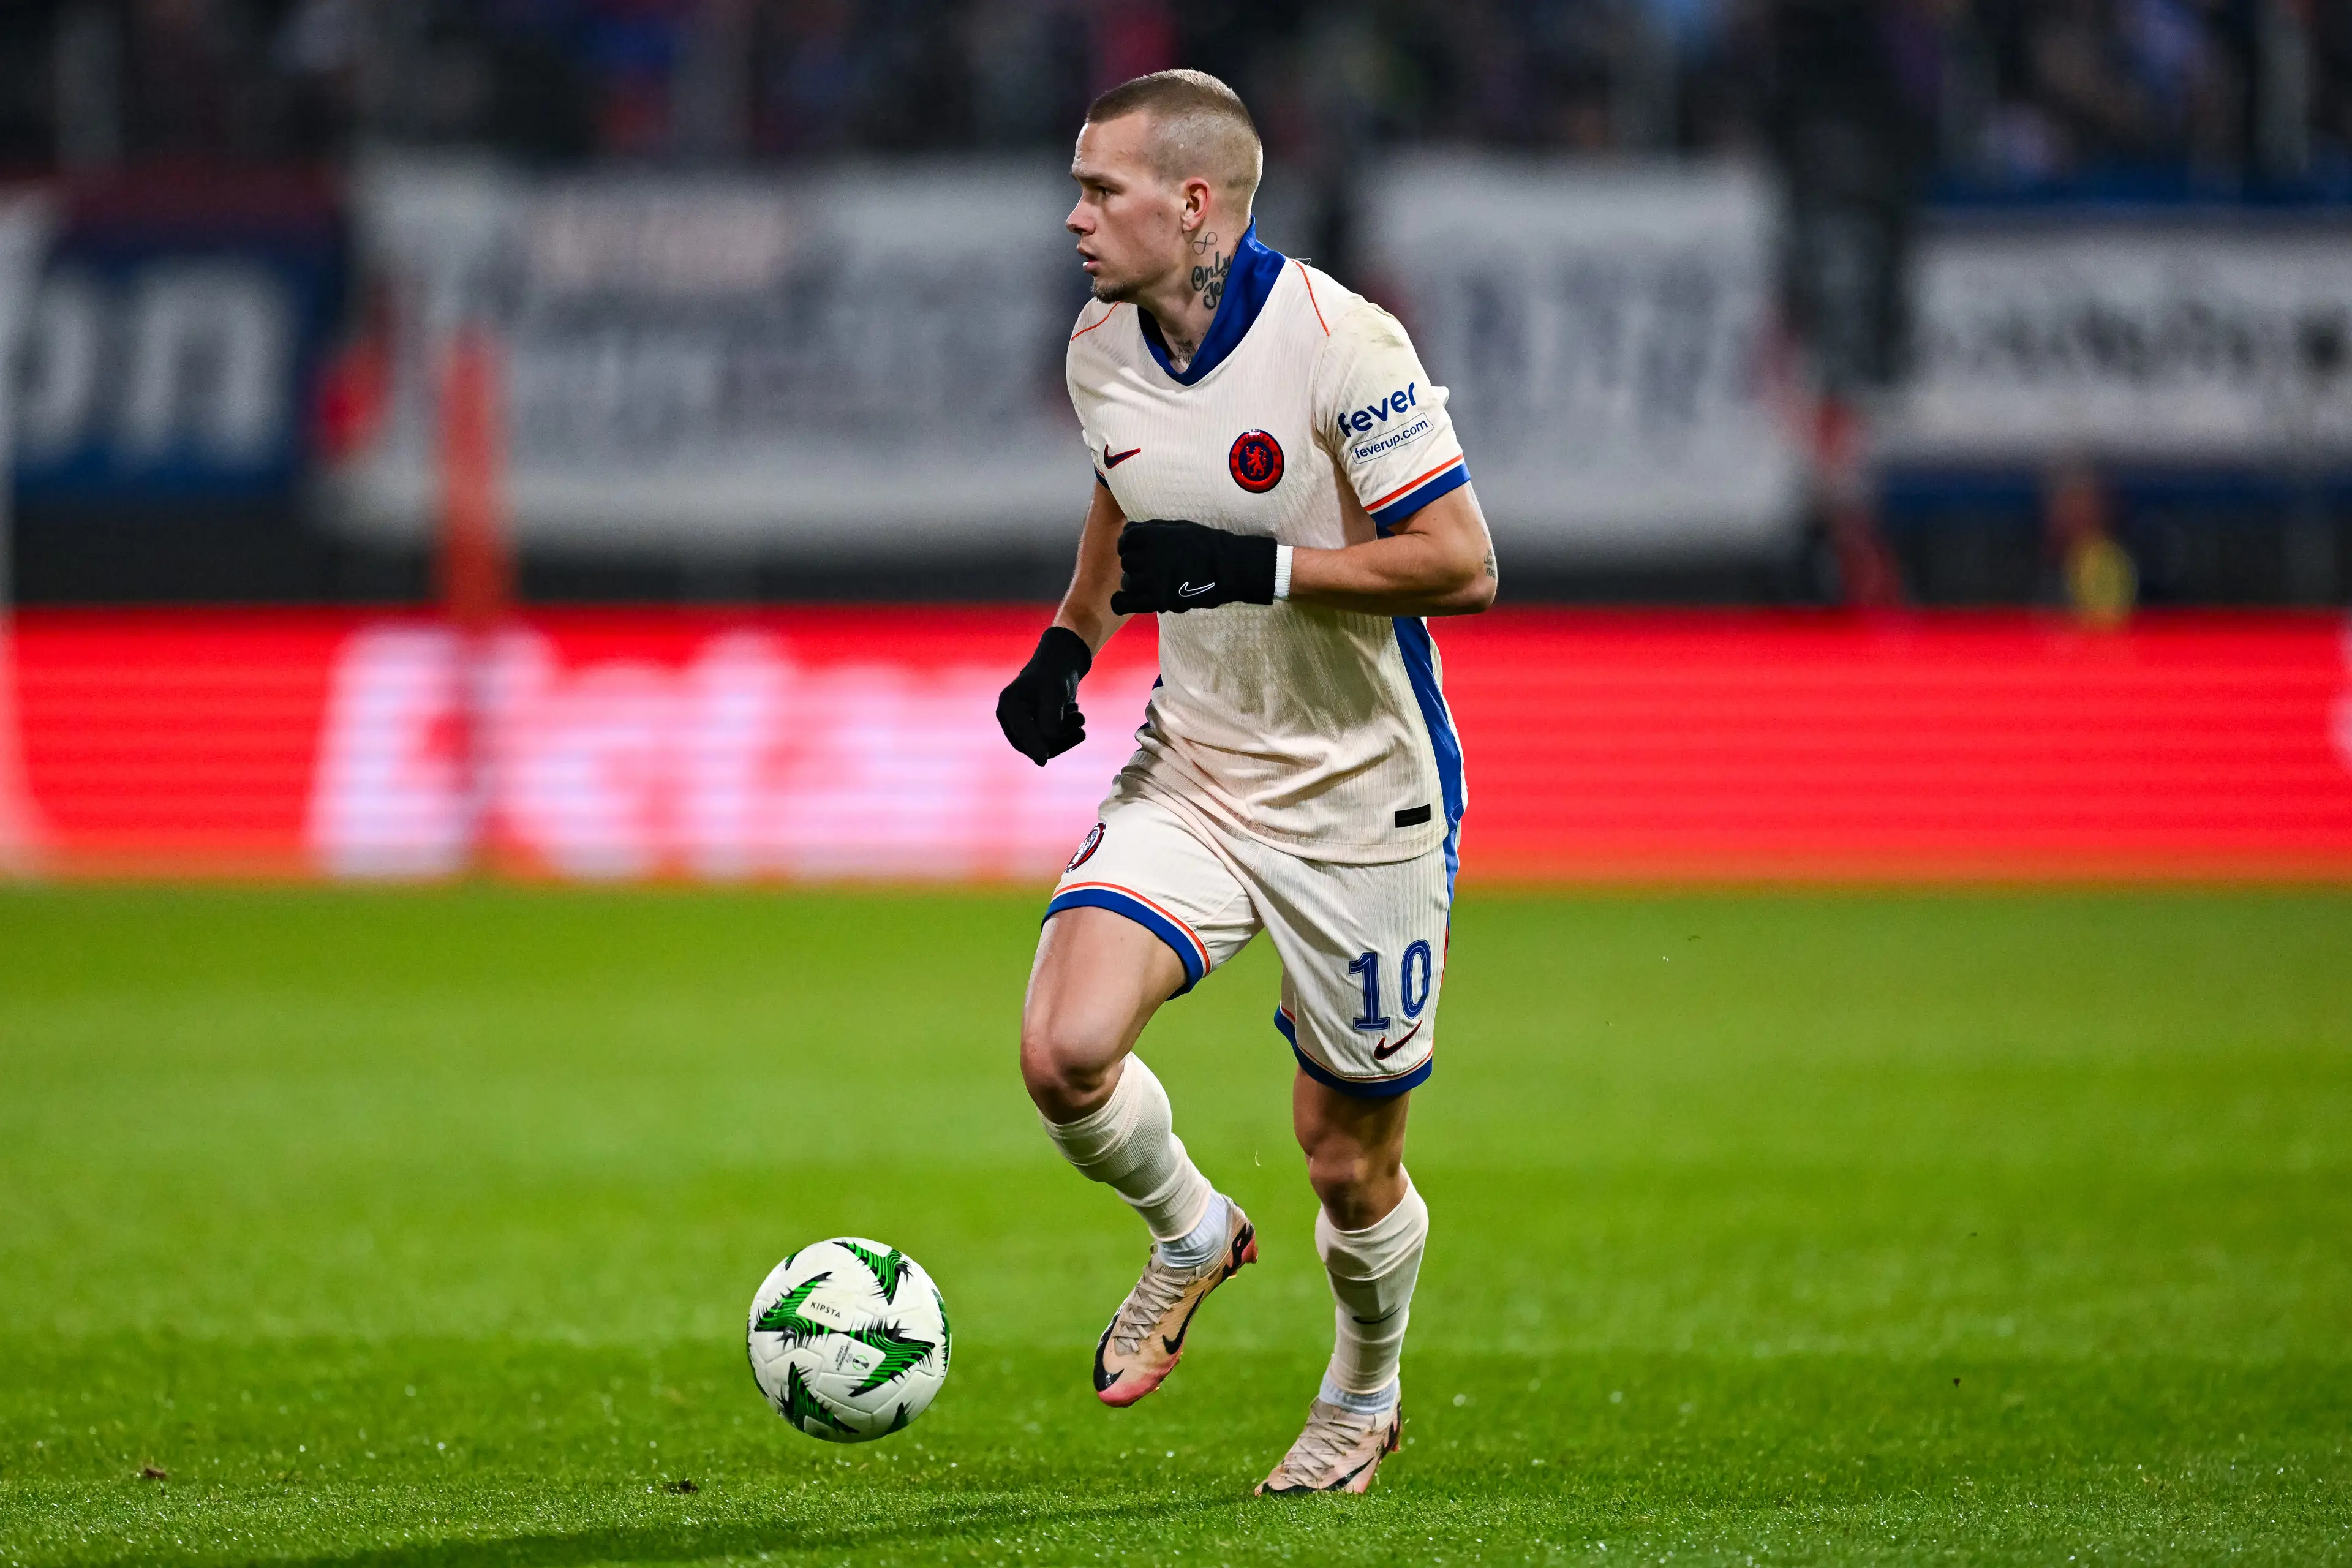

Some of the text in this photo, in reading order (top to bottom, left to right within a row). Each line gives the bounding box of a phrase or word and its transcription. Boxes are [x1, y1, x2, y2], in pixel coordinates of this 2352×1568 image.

[1338, 382, 1417, 437] fever
[1354, 420, 1428, 459] feverup.com
[1349, 939, 1432, 1031] 10
[810, 1300, 840, 1319] KIPSTA
